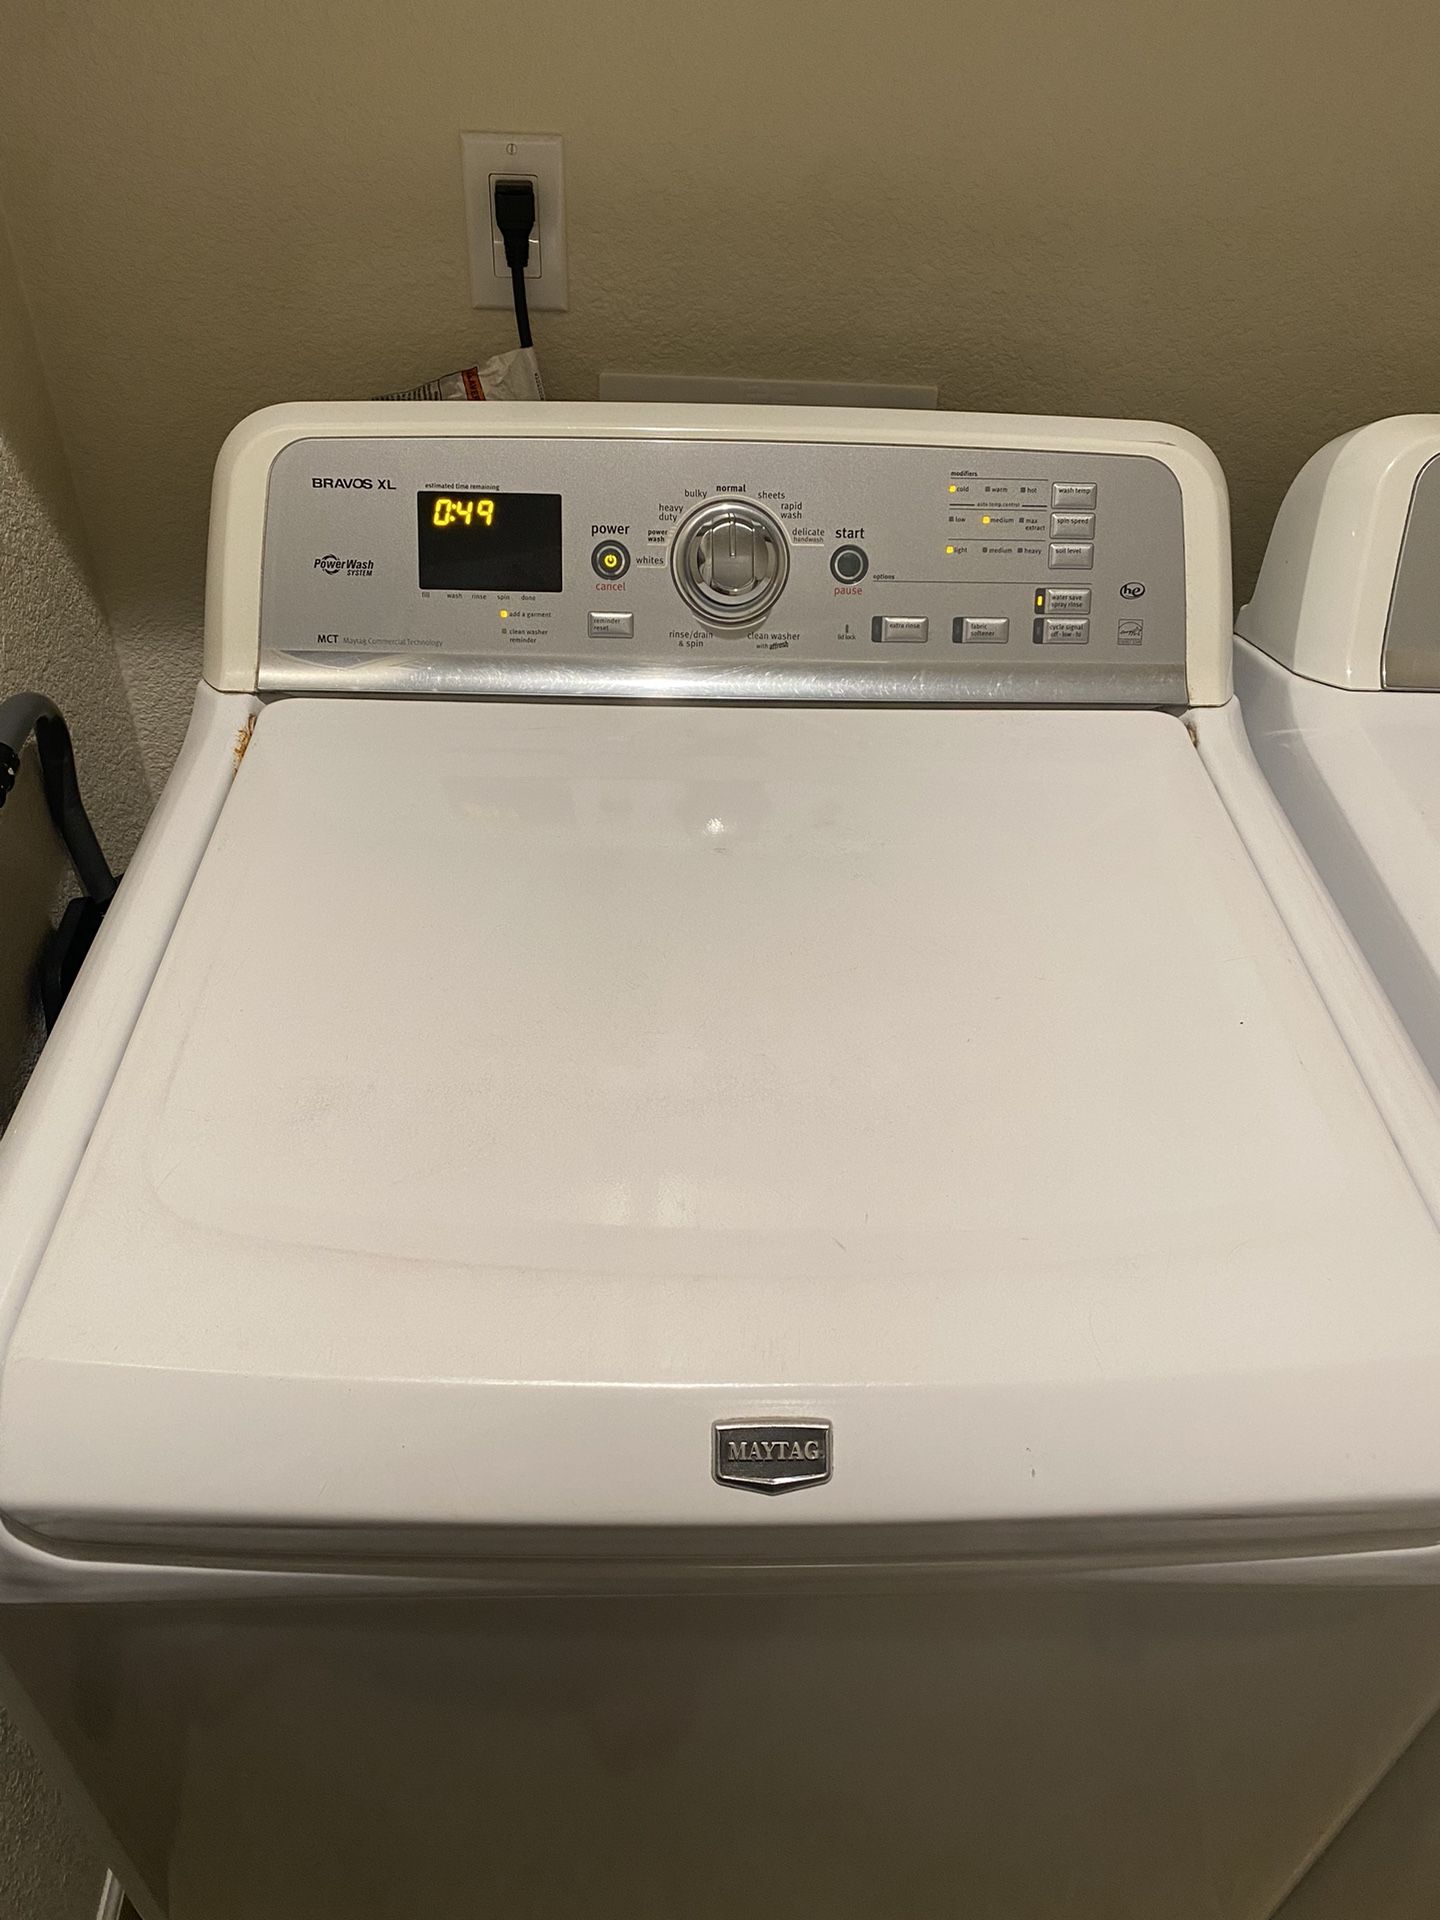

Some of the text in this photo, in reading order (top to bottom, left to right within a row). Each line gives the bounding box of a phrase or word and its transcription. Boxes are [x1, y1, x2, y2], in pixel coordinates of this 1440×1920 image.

[311, 477, 397, 490] BRAVOS XL
[469, 483, 500, 491] remaining
[715, 483, 747, 493] normal
[684, 488, 708, 499] bulky
[956, 485, 970, 493] cold
[1026, 486, 1038, 494] hot
[1058, 487, 1091, 496] wash temp
[757, 490, 786, 500] sheets
[658, 503, 684, 513] heavy
[780, 501, 803, 512] rapid
[433, 498, 495, 527] 0:49
[780, 511, 803, 520] wash
[658, 512, 678, 523] duty
[955, 515, 966, 523] low
[990, 516, 1015, 524] medium
[591, 524, 631, 537] power
[647, 529, 668, 537] power
[792, 527, 825, 537] delicate
[835, 527, 865, 539] start
[988, 546, 1013, 554] medium
[1023, 547, 1042, 555] heavy
[635, 555, 665, 565] whites
[347, 569, 373, 577] SYSTEM
[872, 573, 896, 581] options
[595, 582, 626, 592] cancel
[833, 586, 863, 597] pause
[421, 591, 431, 599] fill
[446, 592, 463, 600] wash
[471, 592, 488, 600] rinse
[496, 593, 511, 602] spin
[520, 593, 537, 601] done
[1051, 601, 1068, 609] spray
[526, 611, 552, 619] garment
[593, 617, 621, 625] reminder
[509, 627, 549, 636] clean washer
[593, 624, 609, 632] reset
[1049, 623, 1084, 632] cycle signal
[669, 629, 714, 640] rinse/drain
[746, 631, 801, 641] clean washer
[837, 633, 857, 641] lid lock
[317, 634, 443, 648] MCT Maytag Commercial Technology
[509, 636, 537, 644] reminder
[678, 639, 704, 649] & spin
[727, 1440, 820, 1461] MAYTAG
